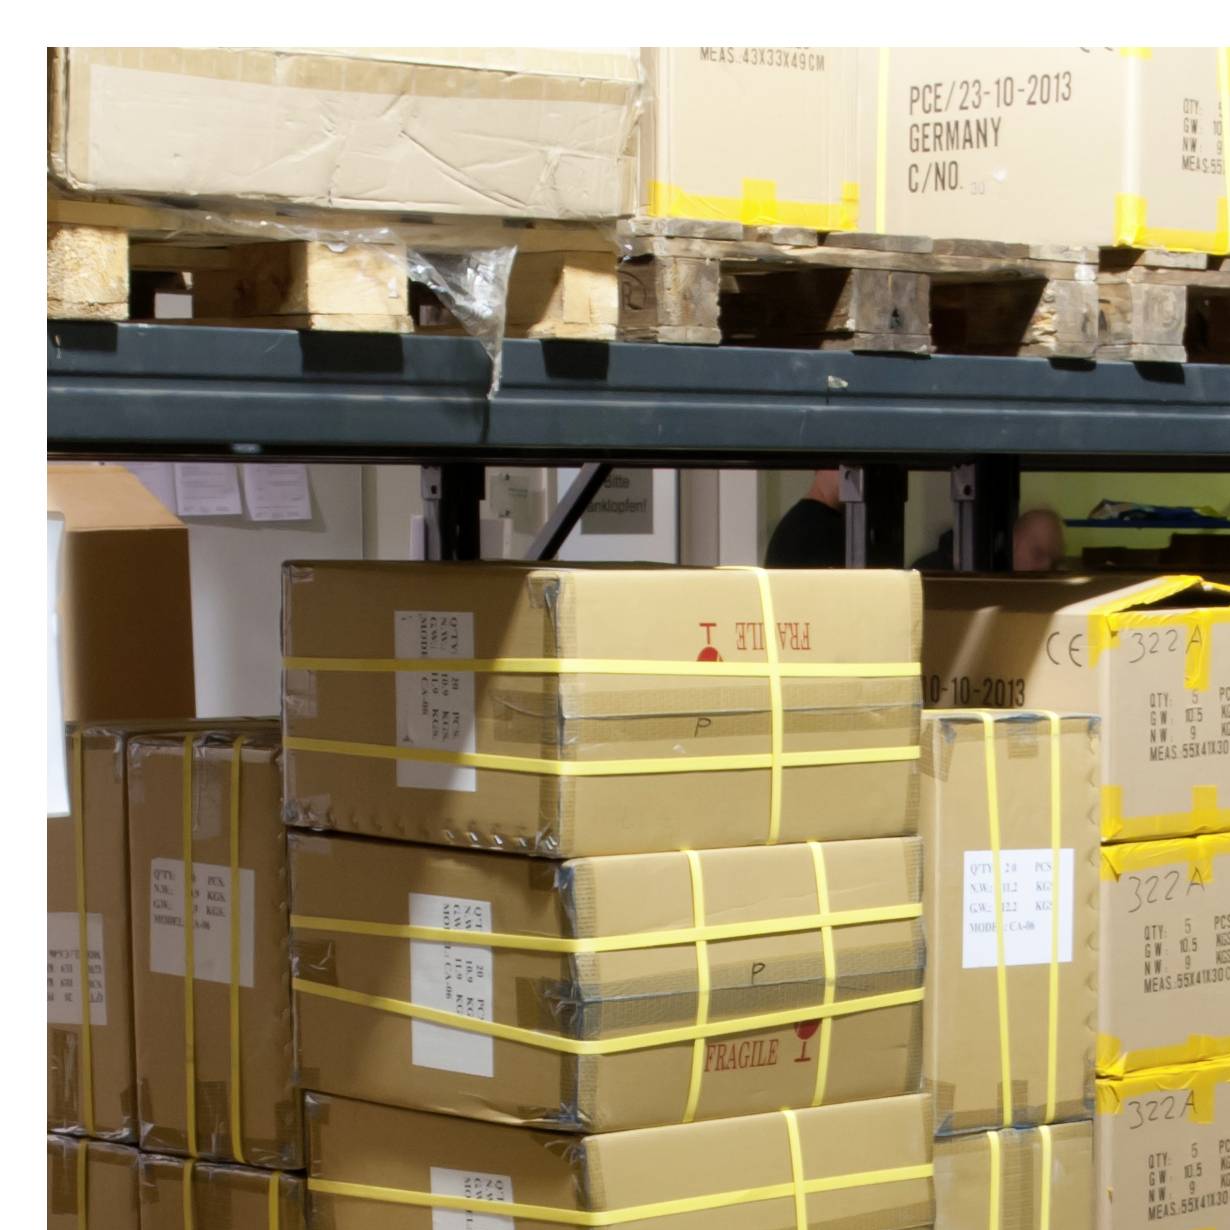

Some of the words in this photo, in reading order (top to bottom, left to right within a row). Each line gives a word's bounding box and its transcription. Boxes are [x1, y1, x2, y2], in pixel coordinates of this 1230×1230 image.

[909, 71, 1072, 115] PCE/23-10-2013
[909, 116, 1001, 152] GERMANY
[908, 161, 963, 193] C/NO.
[735, 622, 811, 651] FRAILE
[1128, 624, 1203, 663] 322A
[1128, 867, 1205, 913] 322A
[704, 1038, 779, 1073] FRAGILE
[1128, 1090, 1198, 1129] 322A
